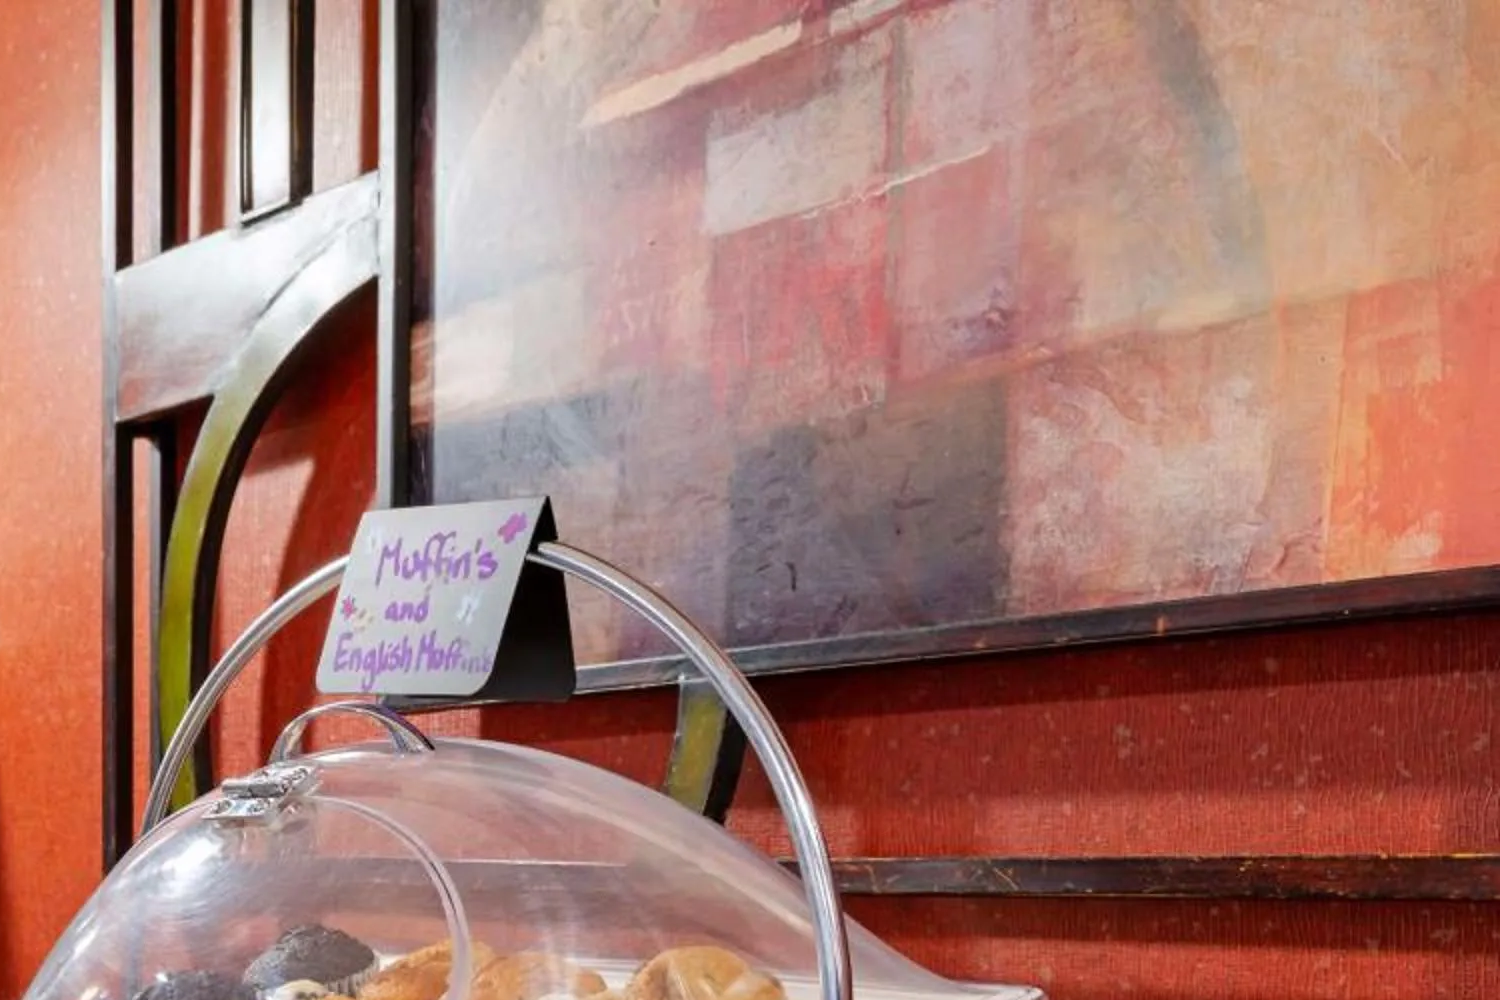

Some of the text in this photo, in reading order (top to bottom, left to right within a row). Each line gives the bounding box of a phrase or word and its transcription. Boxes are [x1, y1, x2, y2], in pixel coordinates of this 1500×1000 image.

[375, 531, 499, 586] Muffin's
[385, 592, 430, 623] and
[333, 632, 412, 691] English
